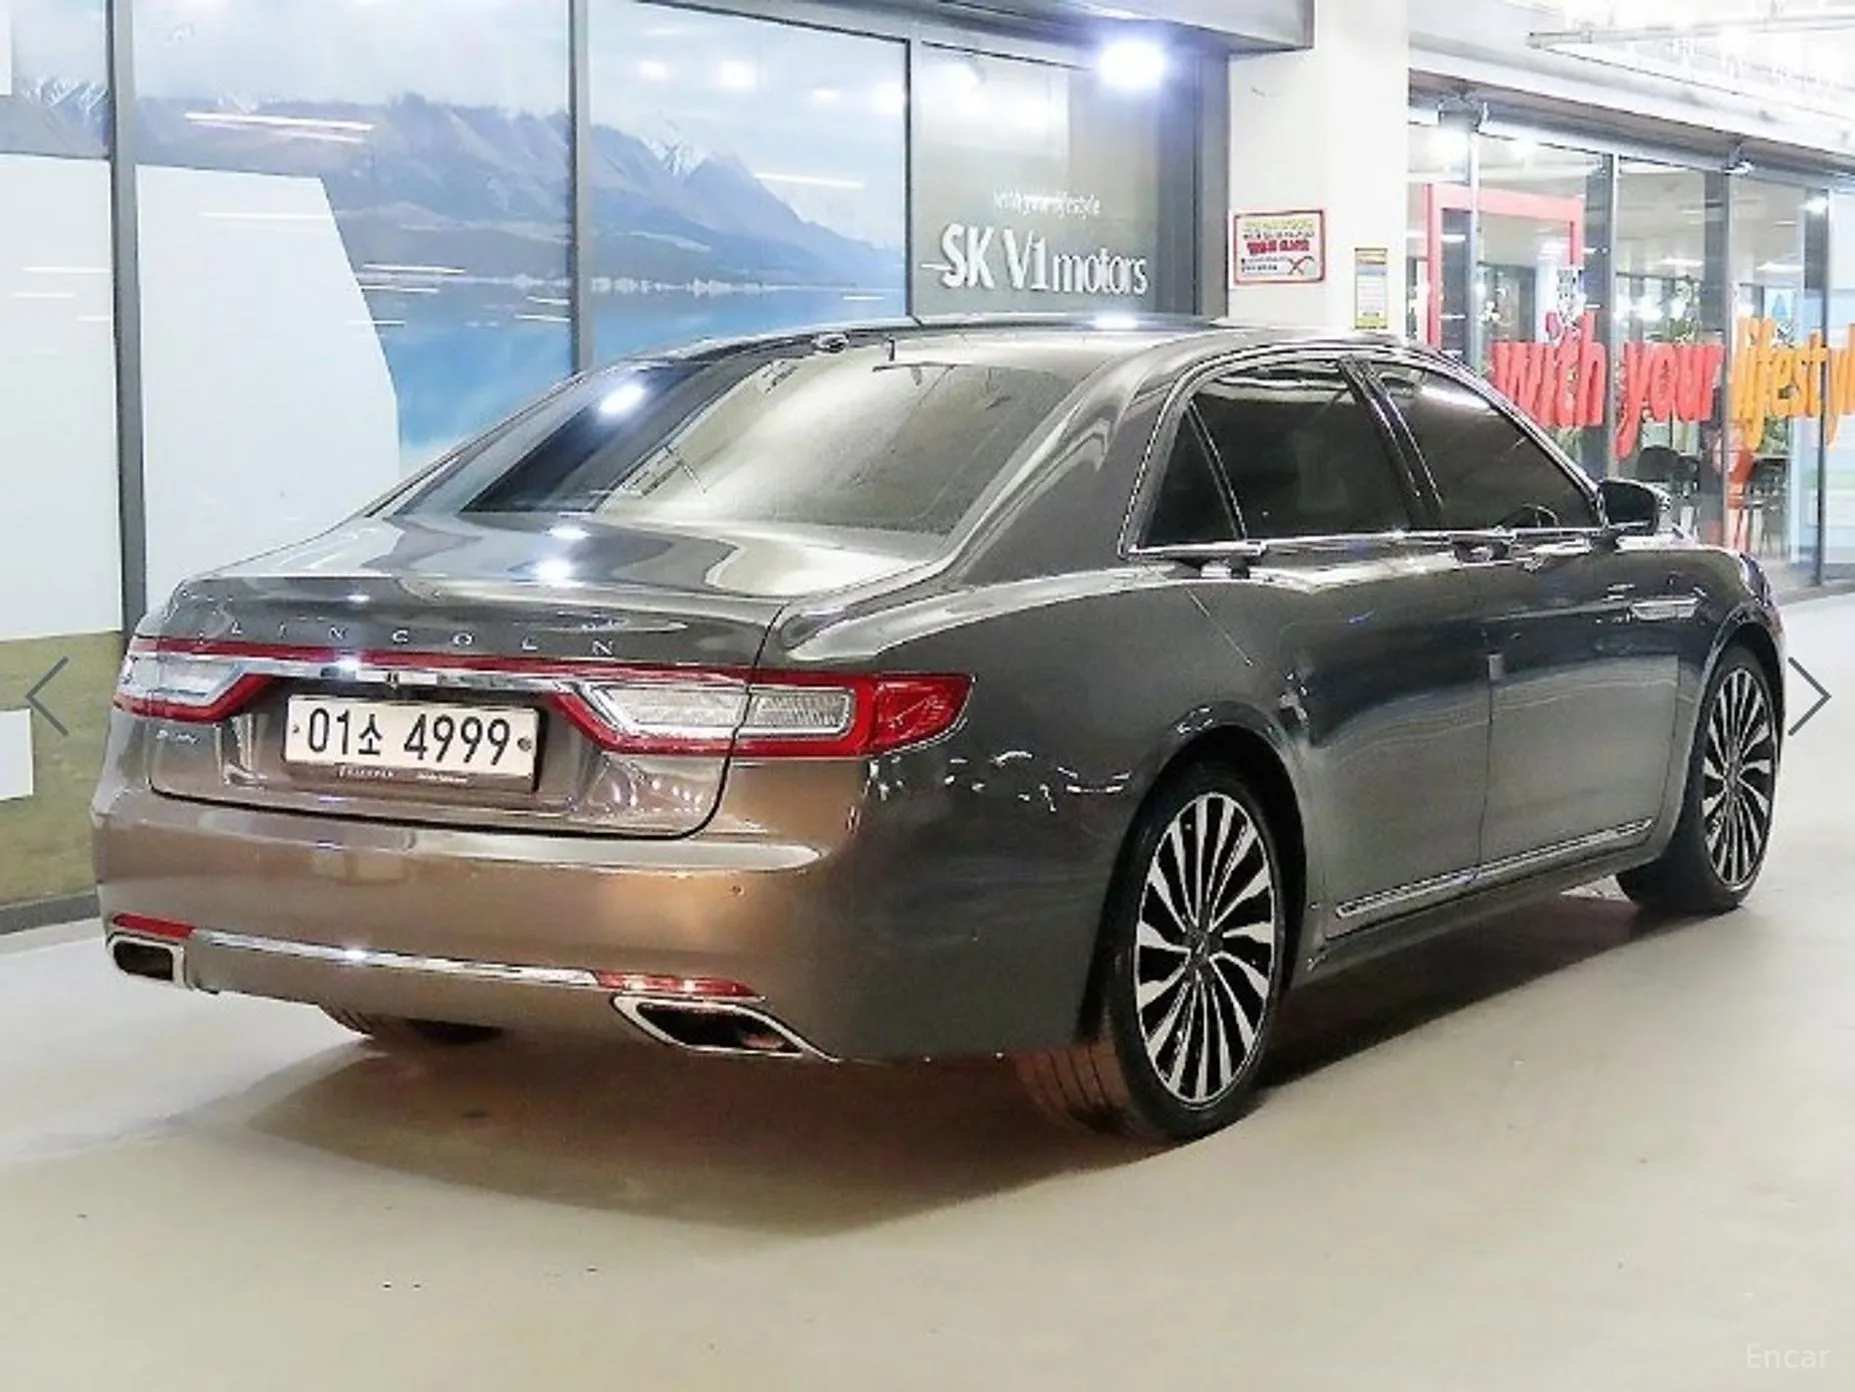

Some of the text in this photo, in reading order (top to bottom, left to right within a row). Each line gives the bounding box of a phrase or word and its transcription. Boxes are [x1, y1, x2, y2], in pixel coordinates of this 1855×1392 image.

[941, 222, 995, 289] SK
[1491, 308, 1607, 430] with
[1613, 340, 1725, 462] your
[230, 620, 615, 657] LINCOLN
[308, 706, 511, 766] 01소 4999
